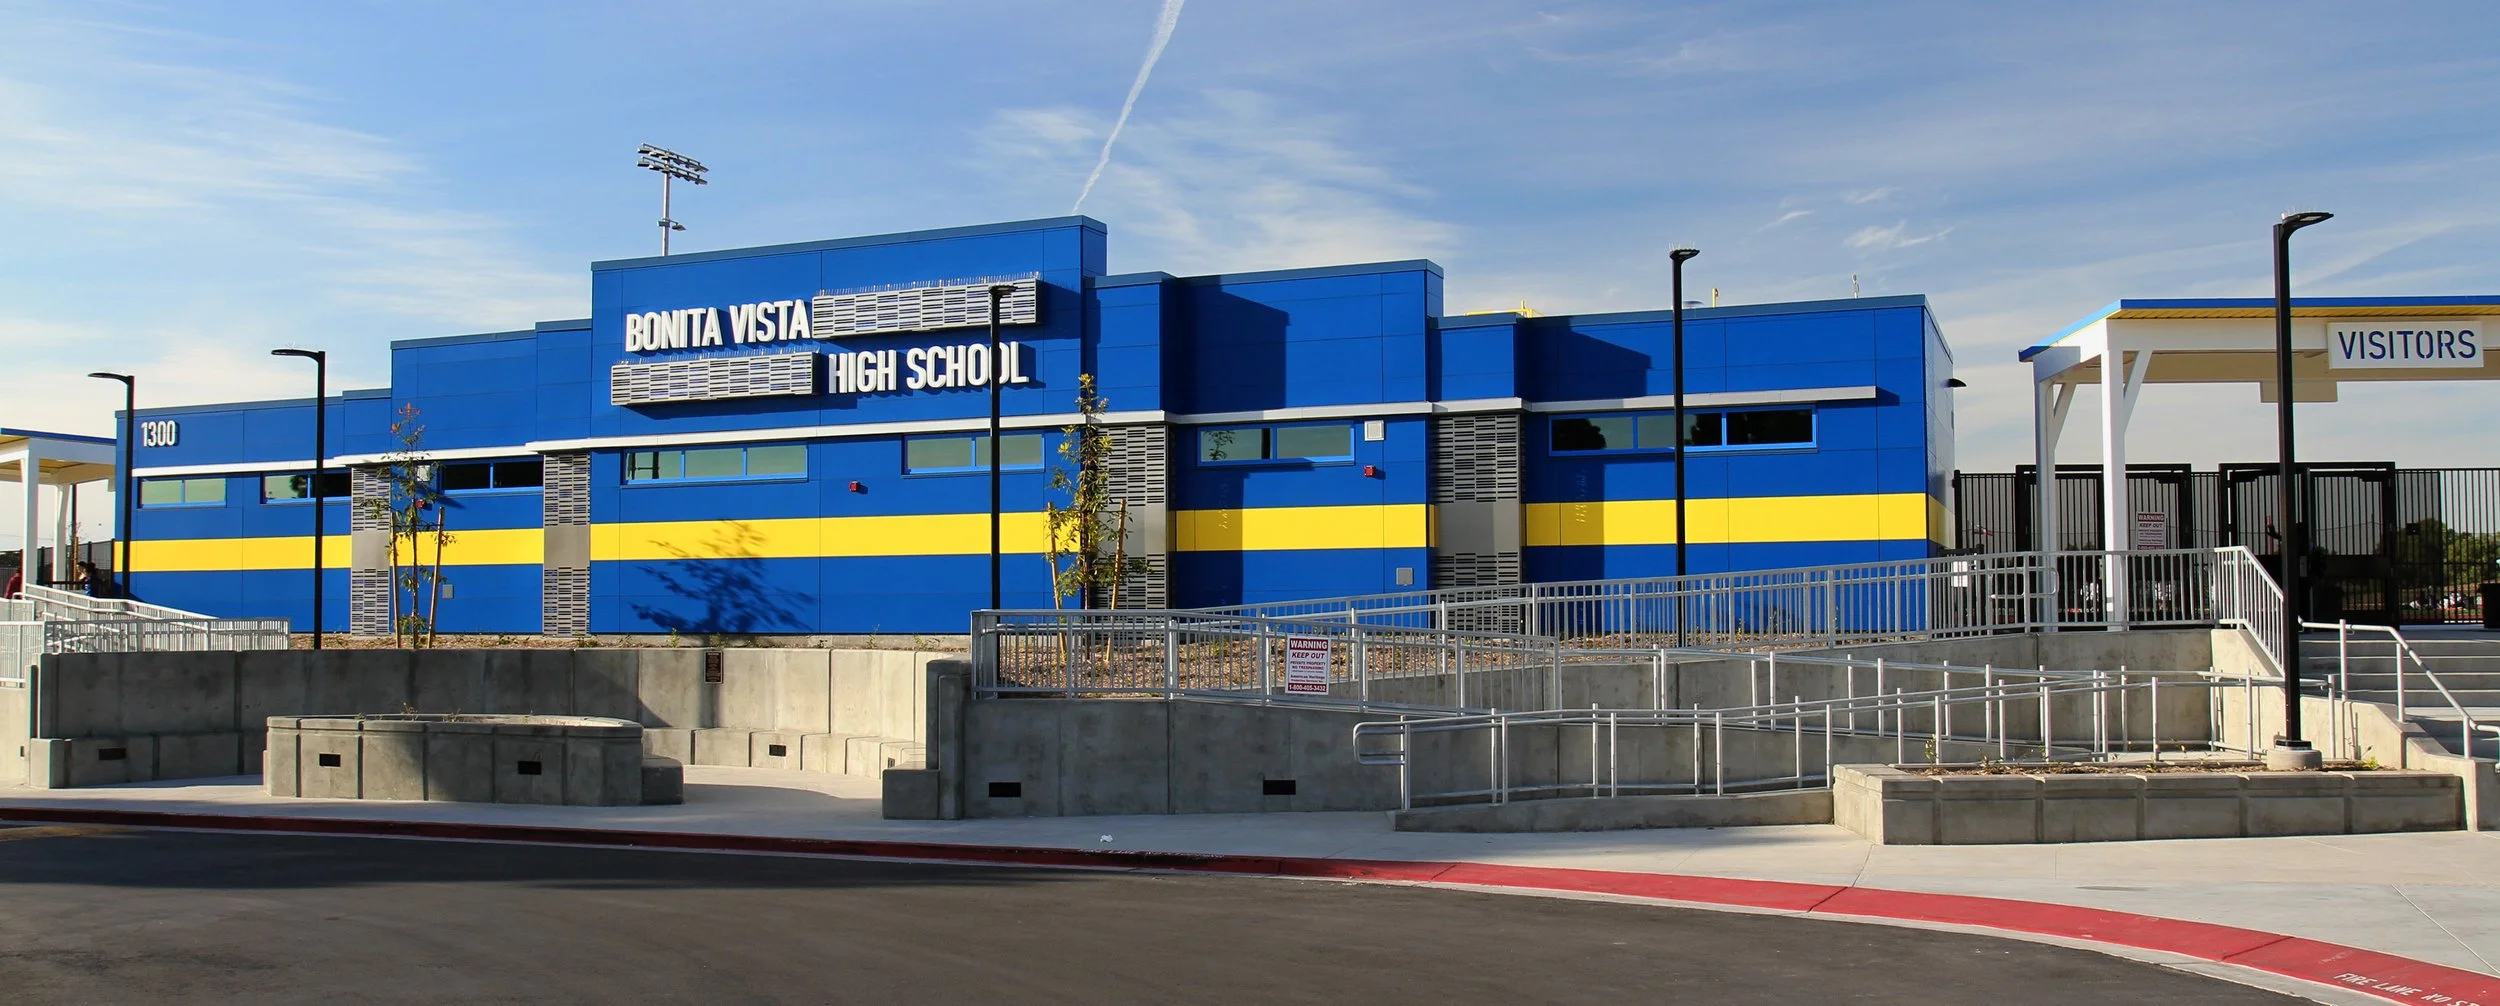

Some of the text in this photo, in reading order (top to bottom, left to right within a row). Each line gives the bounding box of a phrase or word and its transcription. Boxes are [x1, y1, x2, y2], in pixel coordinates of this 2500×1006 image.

[625, 299, 812, 352] BONITA VISTA
[2337, 329, 2476, 360] VISITORS
[828, 341, 1030, 394] HIGH SCHOOL
[141, 420, 176, 447] 1300
[1290, 640, 1328, 649] WARNING
[2333, 972, 2378, 986] FIRE
[2372, 982, 2422, 996] LANE
[2421, 993, 2452, 1004] NO
